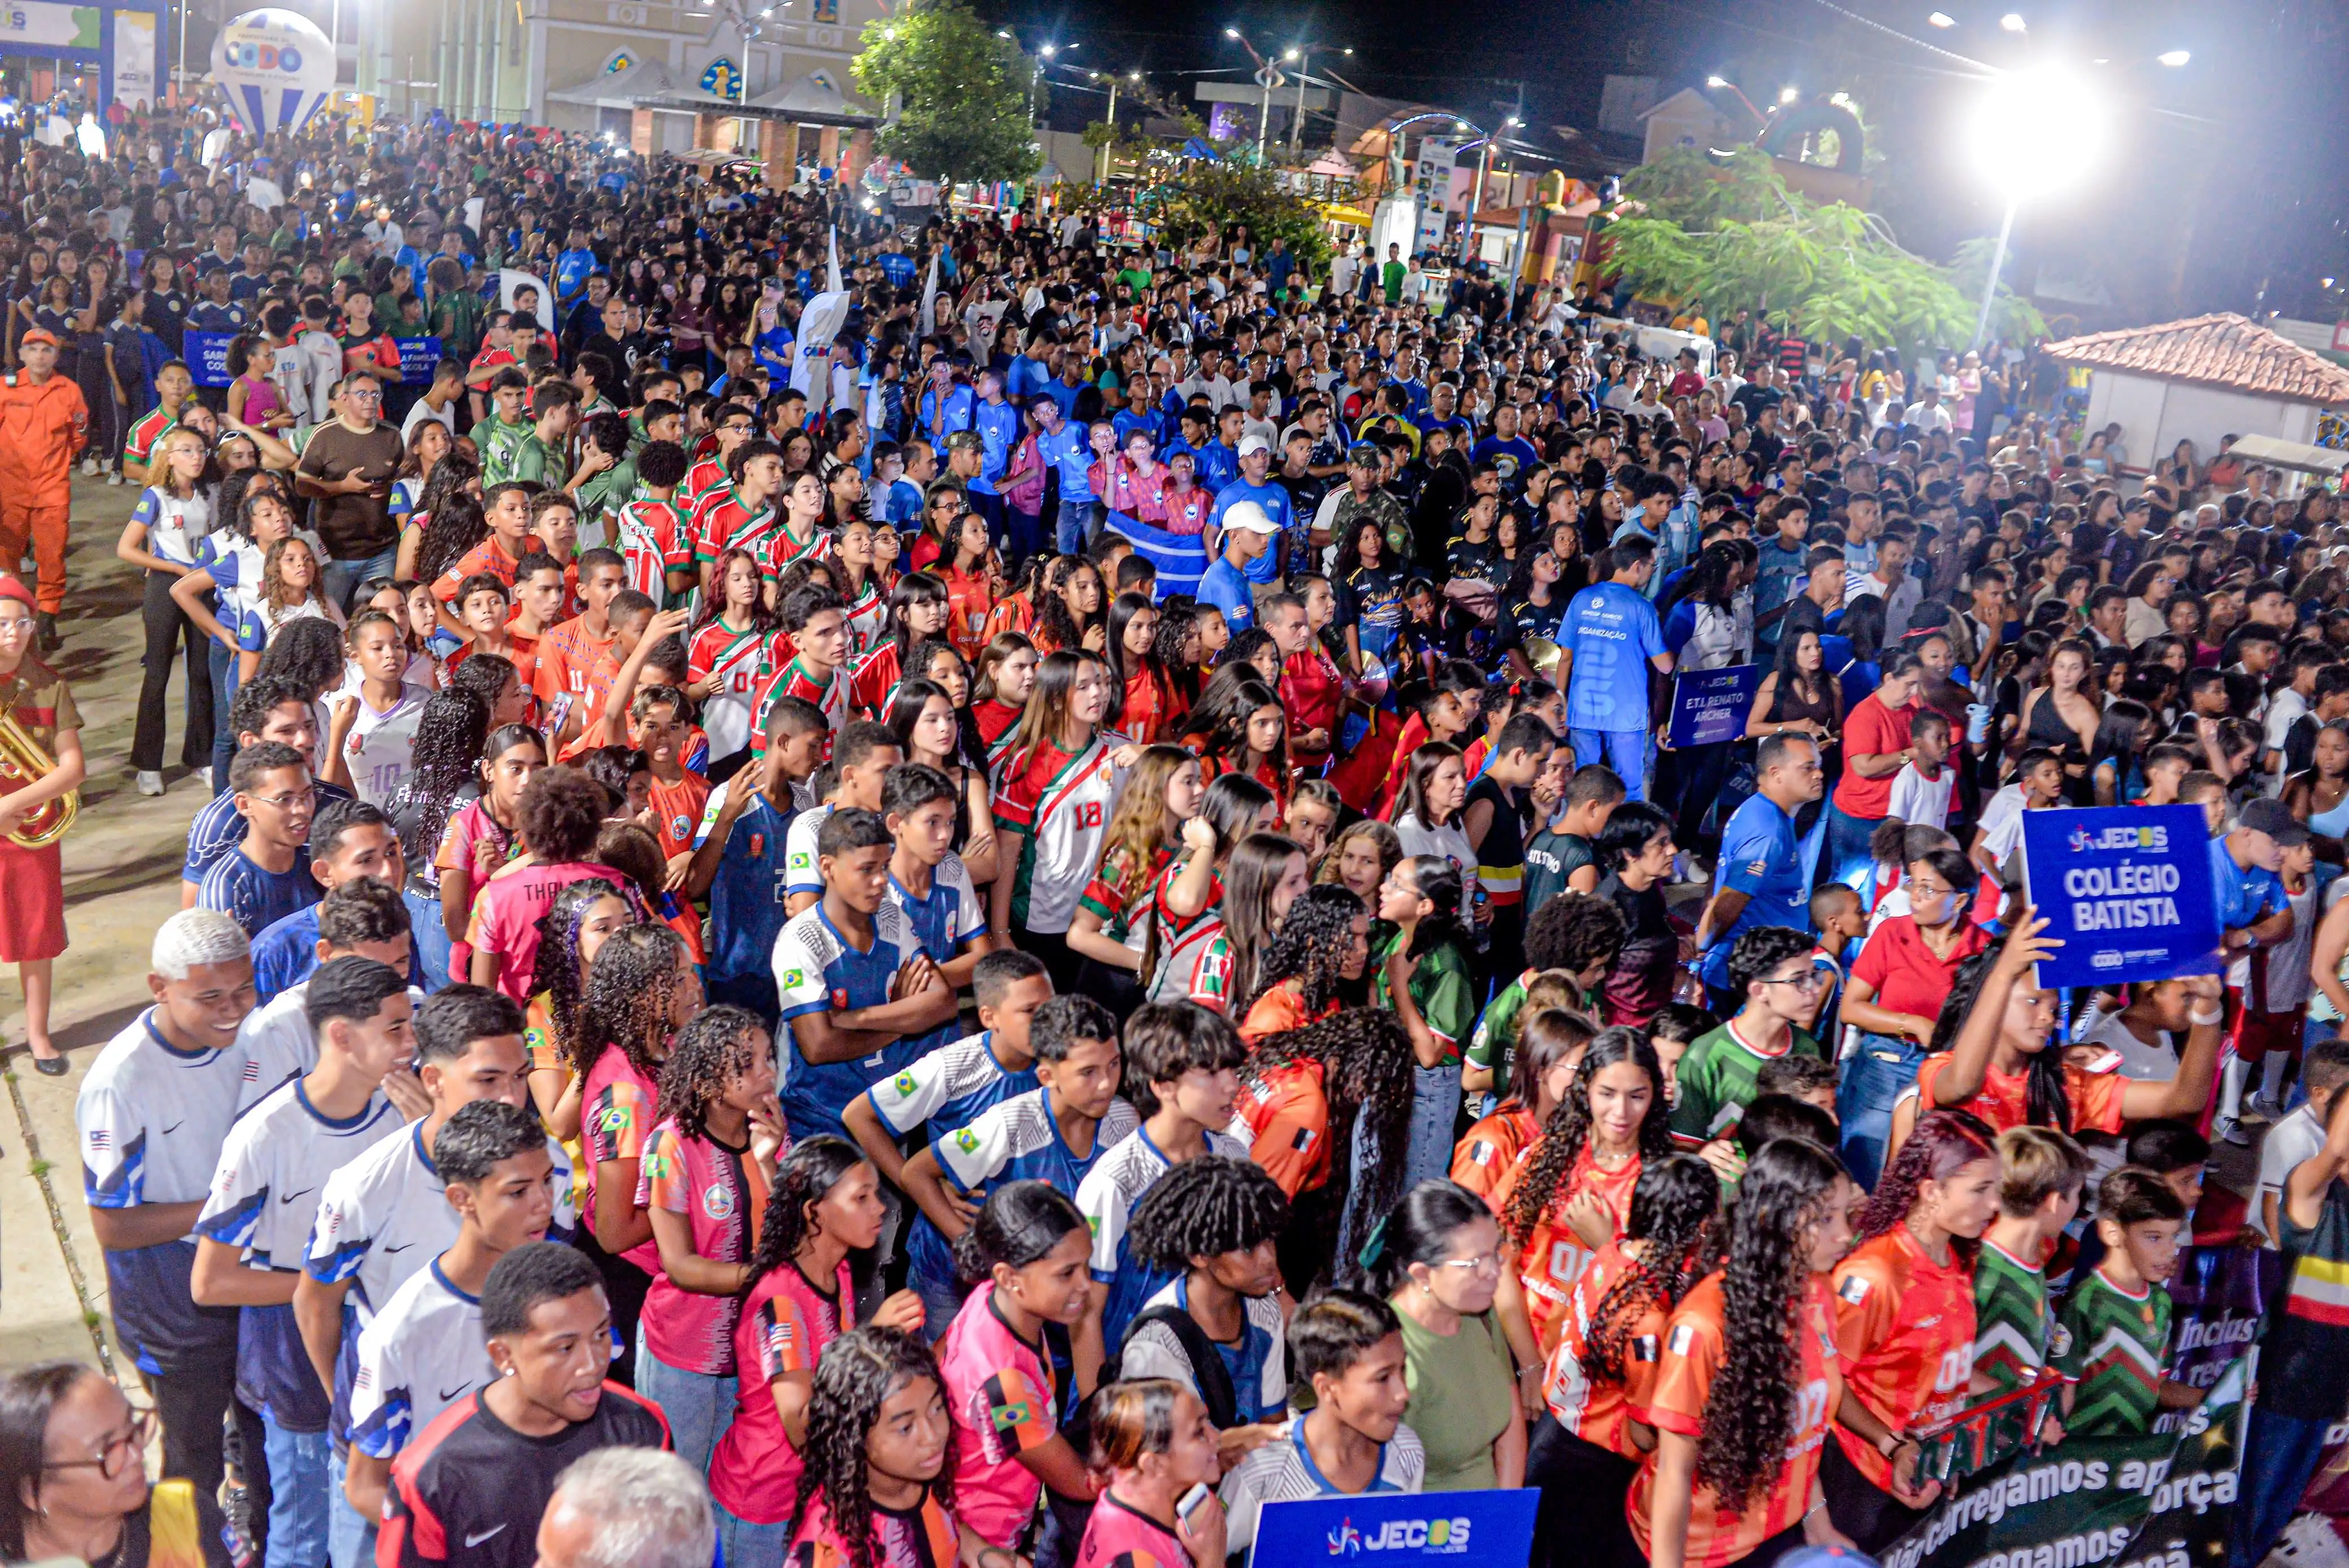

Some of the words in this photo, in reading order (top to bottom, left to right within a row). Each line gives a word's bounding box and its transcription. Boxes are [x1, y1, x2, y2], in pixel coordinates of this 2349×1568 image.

[569, 670, 584, 692] 11
[1707, 692, 1743, 707] RENATO
[1693, 707, 1732, 723] ARCHER
[373, 763, 400, 792] 10
[1075, 801, 1102, 831] 18
[2096, 826, 2169, 849] JECOS
[2064, 858, 2180, 898] COLÉGIO
[2072, 897, 2181, 931] BATISTA
[1924, 1460, 2109, 1555] carregamos
[1364, 1517, 1472, 1551] JECOS
